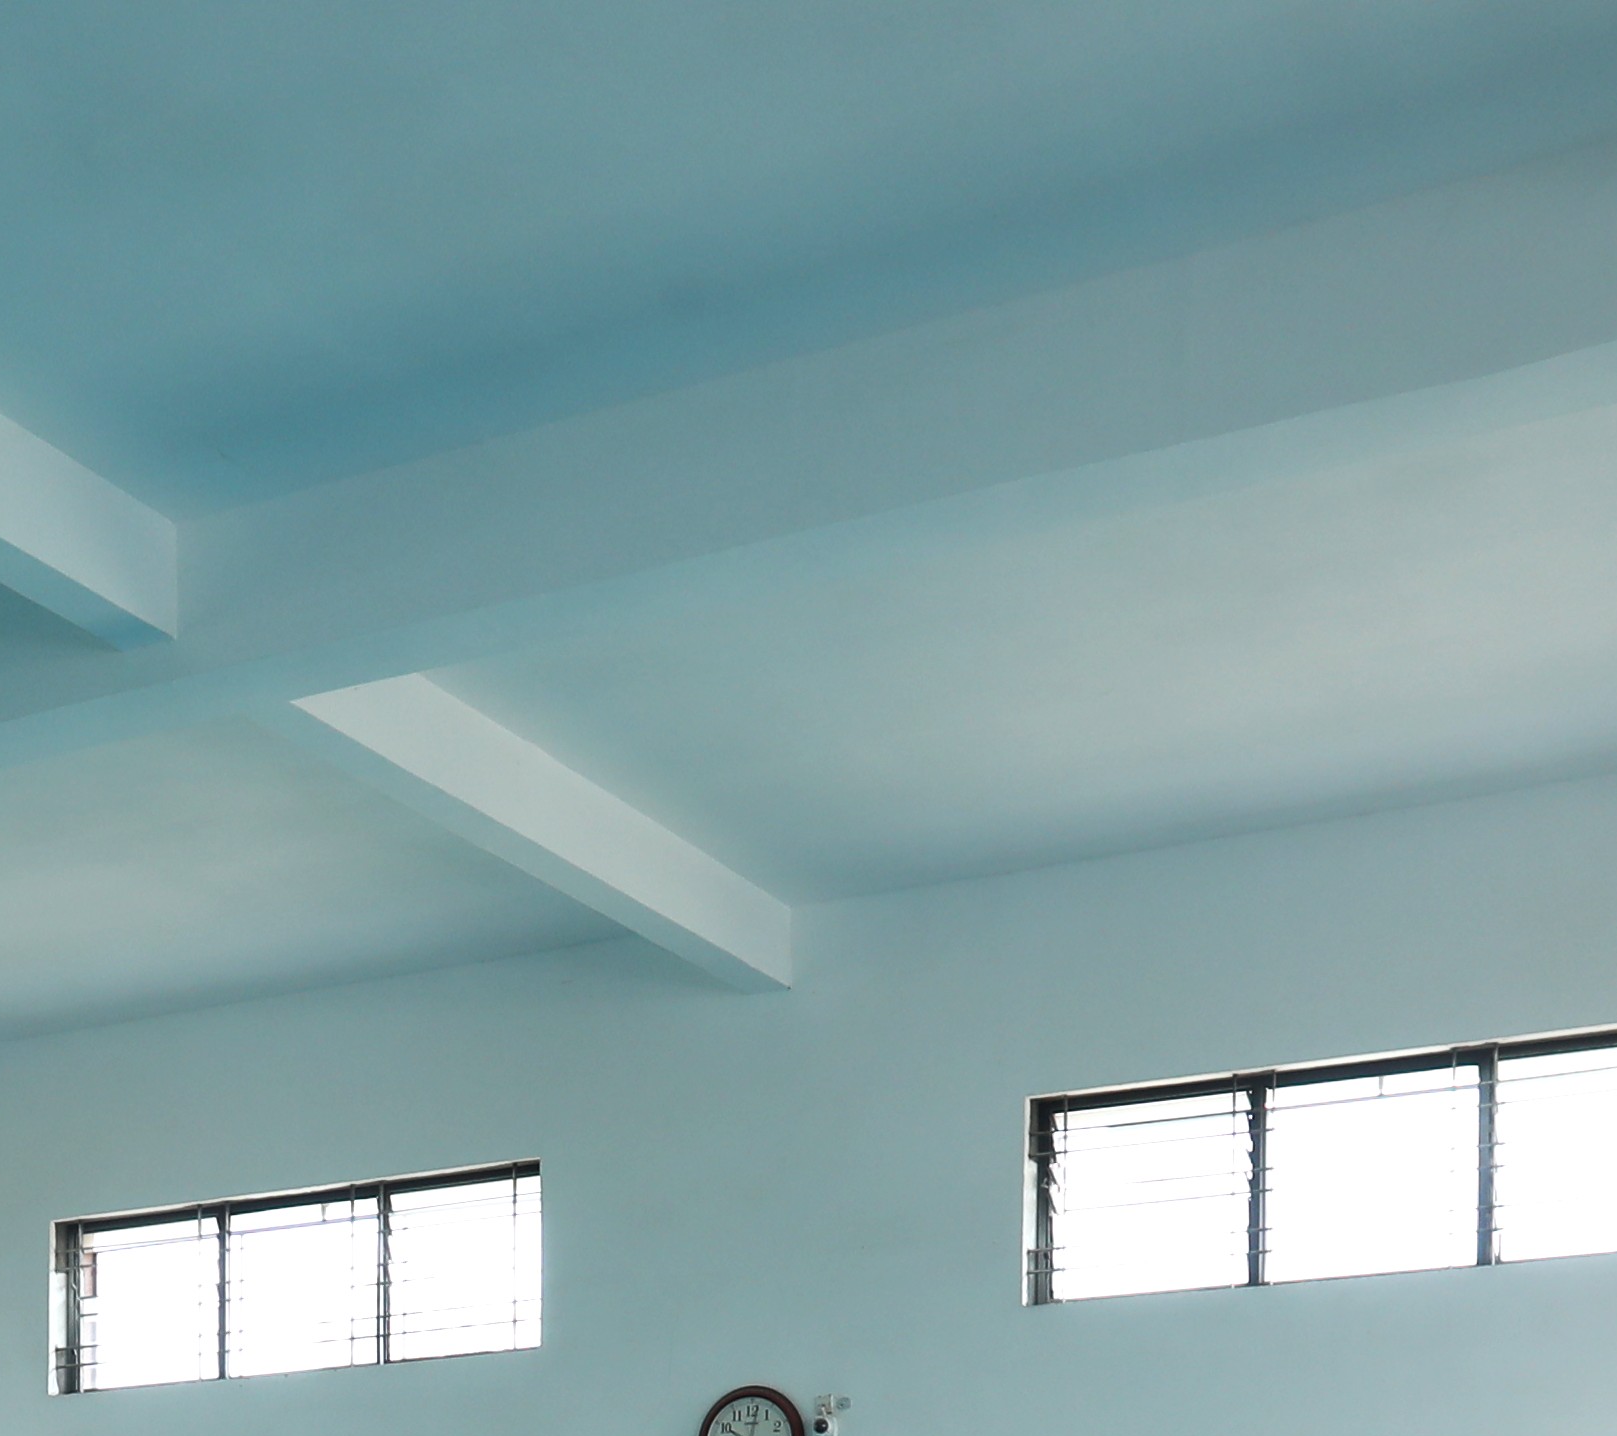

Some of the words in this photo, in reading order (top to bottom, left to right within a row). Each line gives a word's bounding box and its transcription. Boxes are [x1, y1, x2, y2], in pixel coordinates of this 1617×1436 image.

[732, 1411, 742, 1422] 11
[746, 1405, 758, 1417] 12
[764, 1409, 769, 1421] 1
[720, 1423, 731, 1433] 10
[773, 1421, 782, 1432] 2
